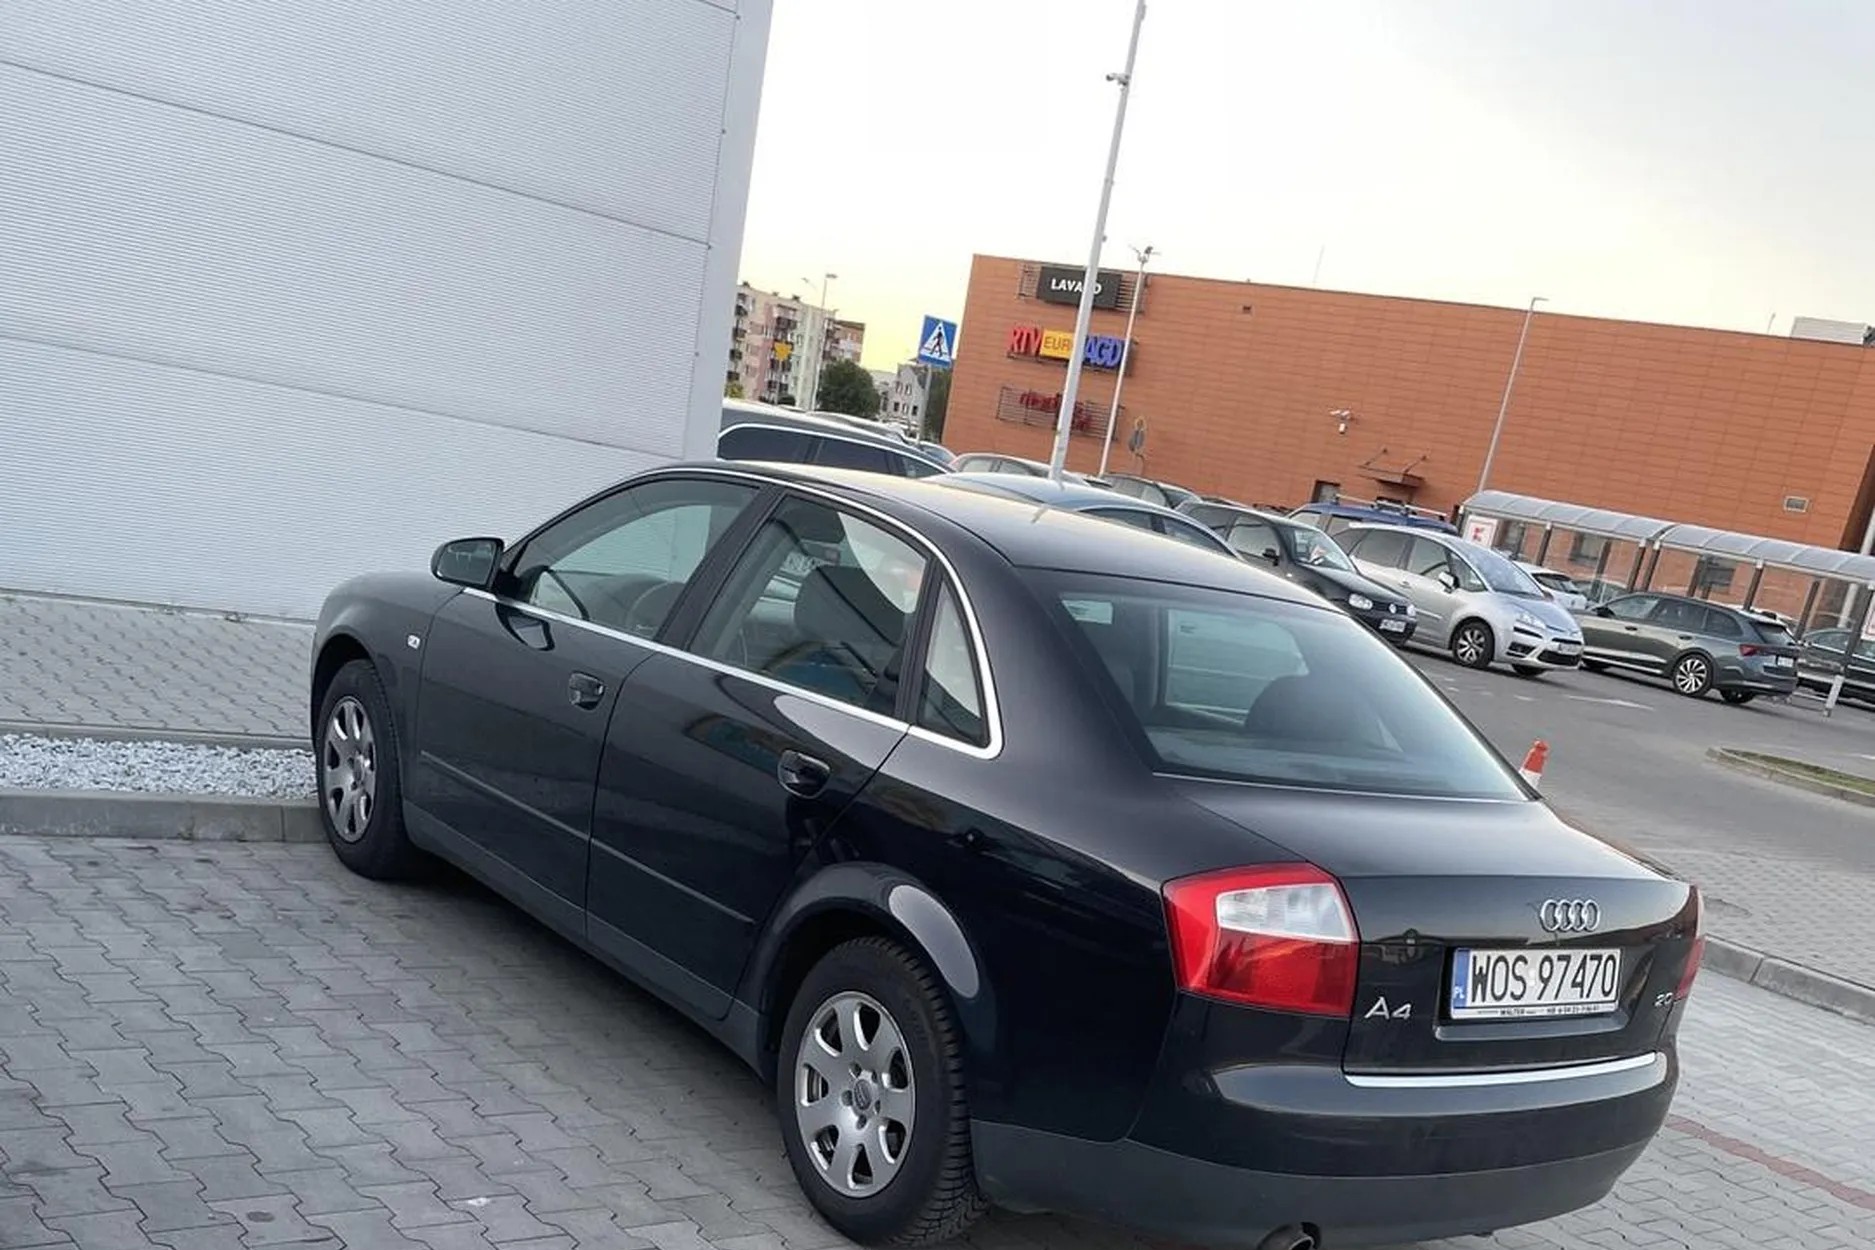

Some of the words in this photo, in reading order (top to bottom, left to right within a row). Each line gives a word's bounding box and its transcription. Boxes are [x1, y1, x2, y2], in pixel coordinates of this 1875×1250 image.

[1051, 277, 1102, 295] LAVAD
[1010, 327, 1041, 356] RTV
[1043, 336, 1070, 351] EUR
[1086, 334, 1124, 367] AGD
[1471, 954, 1528, 1003] WOS
[1536, 953, 1616, 1001] 97470
[1364, 996, 1412, 1020] A4
